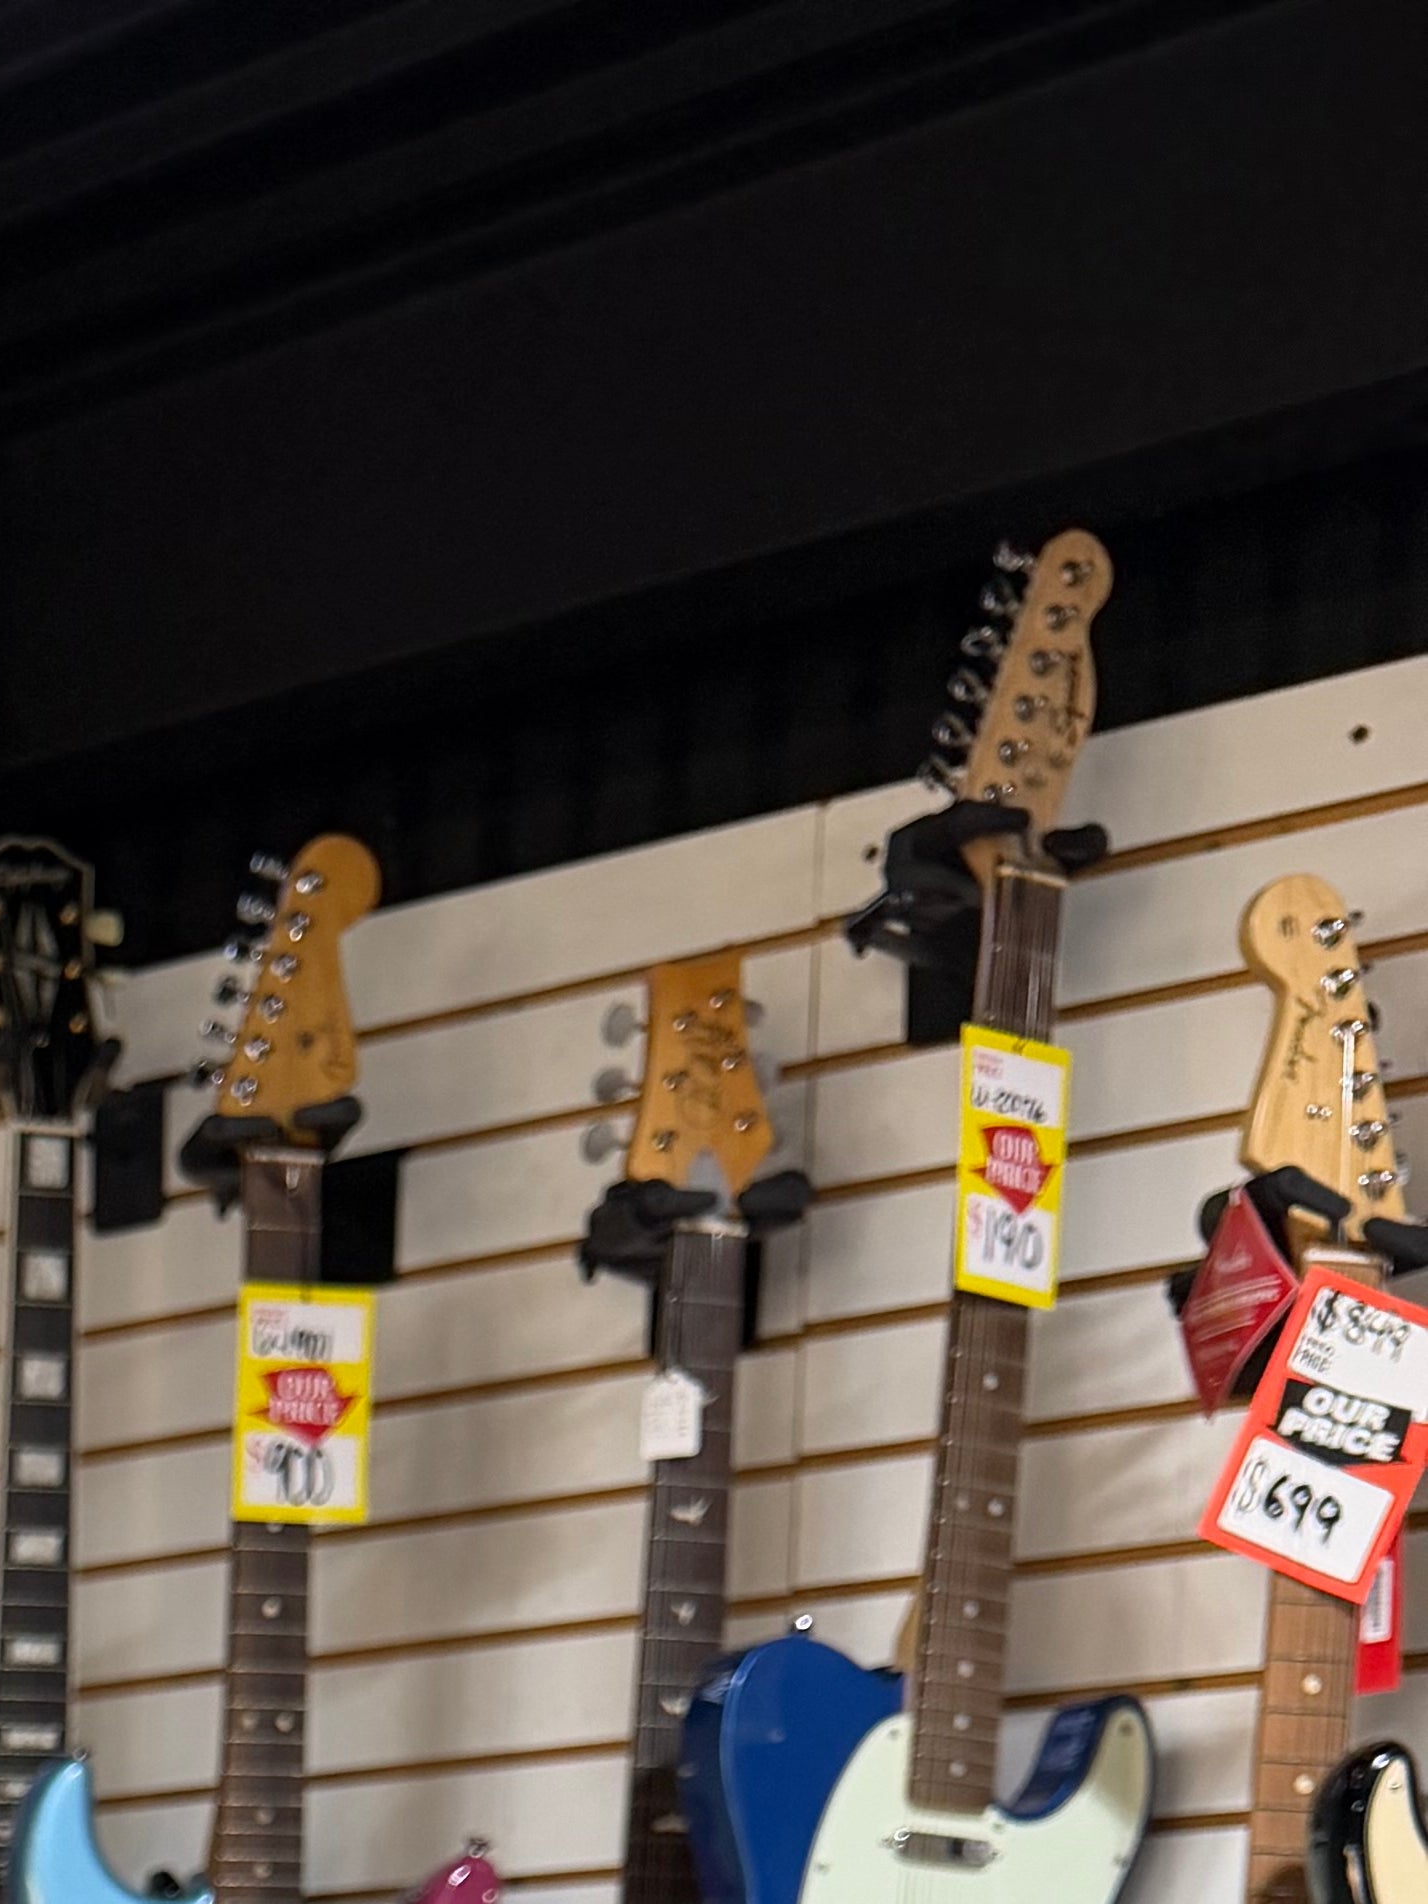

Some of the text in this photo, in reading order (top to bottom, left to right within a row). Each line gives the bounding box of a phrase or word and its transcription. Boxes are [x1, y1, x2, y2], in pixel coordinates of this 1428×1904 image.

[1276, 1406, 1401, 1464] PRICE
[1301, 1386, 1391, 1432] OUR
[1230, 1456, 1343, 1546] $699
